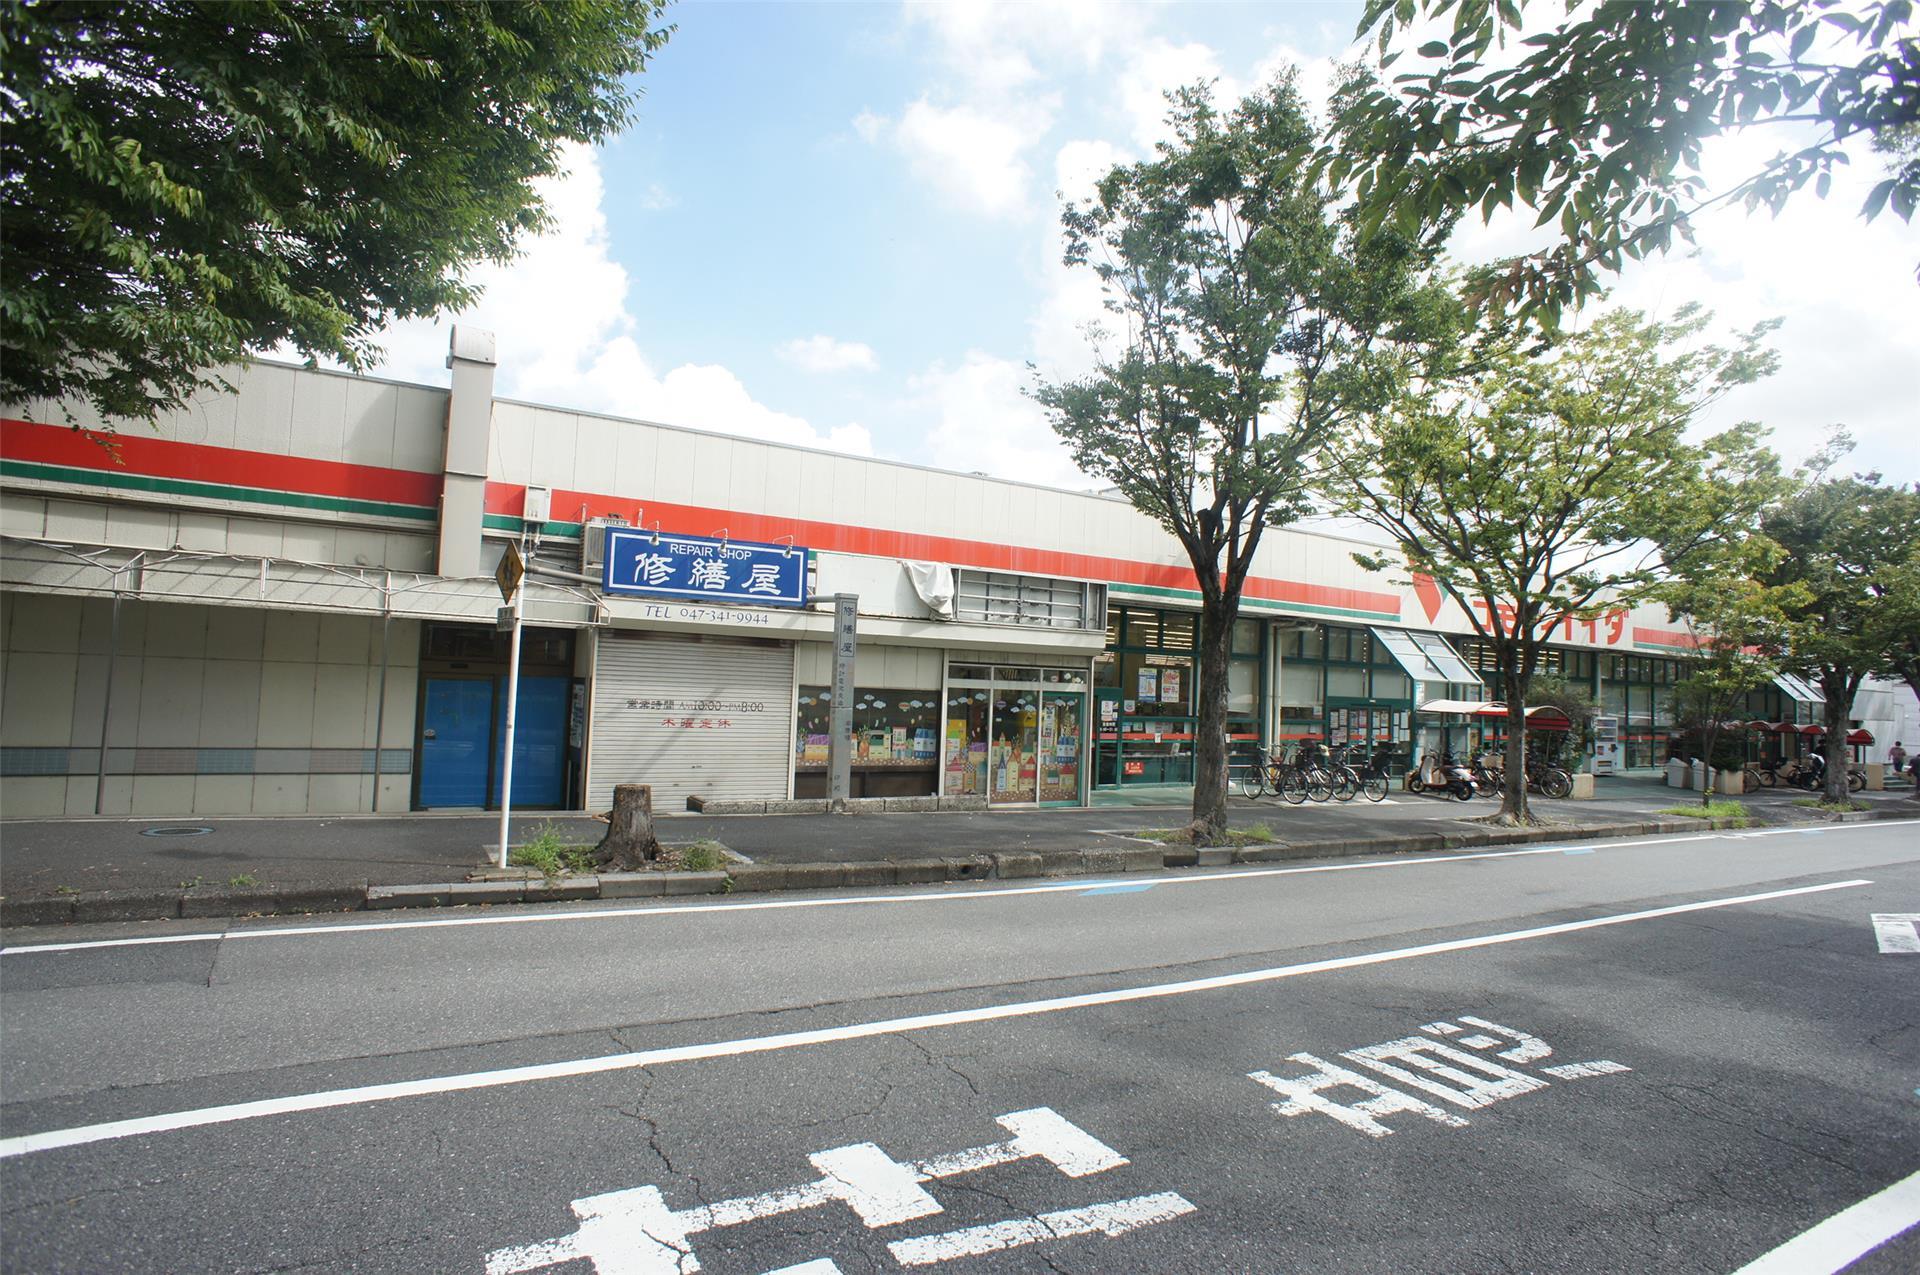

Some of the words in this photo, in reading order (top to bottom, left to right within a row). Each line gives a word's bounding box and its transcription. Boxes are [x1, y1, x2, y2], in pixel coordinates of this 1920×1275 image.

[670, 543, 714, 558] REPAIR
[719, 546, 752, 561] SHOP
[634, 552, 783, 596] 修繕屋
[645, 605, 672, 619] TEL
[680, 607, 769, 625] 047-341-9944
[626, 699, 675, 710] 営業時間
[661, 718, 732, 728] 木曜定休
